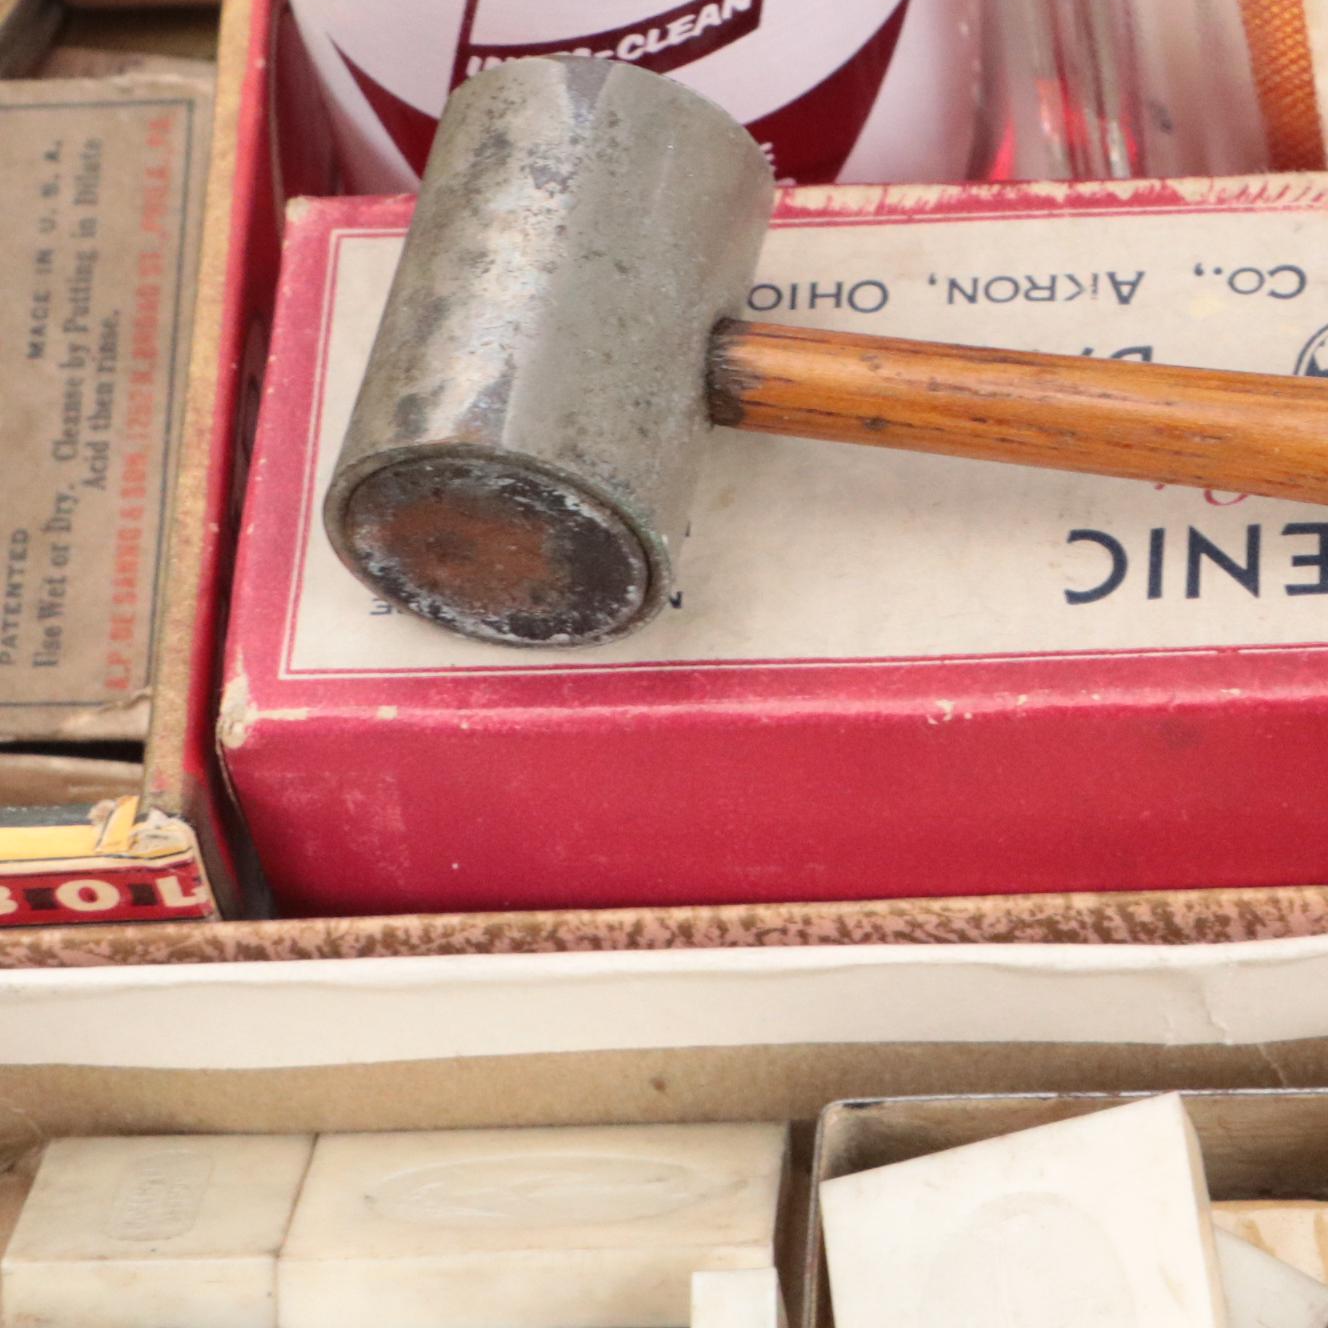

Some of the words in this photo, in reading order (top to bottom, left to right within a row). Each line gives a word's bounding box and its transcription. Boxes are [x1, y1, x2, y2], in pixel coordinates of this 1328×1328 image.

[34, 249, 54, 274] IN
[1192, 262, 1308, 301] CO.,
[746, 279, 890, 314] OHIO
[57, 343, 90, 368] by
[86, 380, 114, 432] then
[82, 441, 110, 491] Acid
[49, 542, 69, 567] or
[0, 528, 29, 666] PATENTED
[35, 576, 67, 620] Wet
[31, 625, 62, 669] Use
